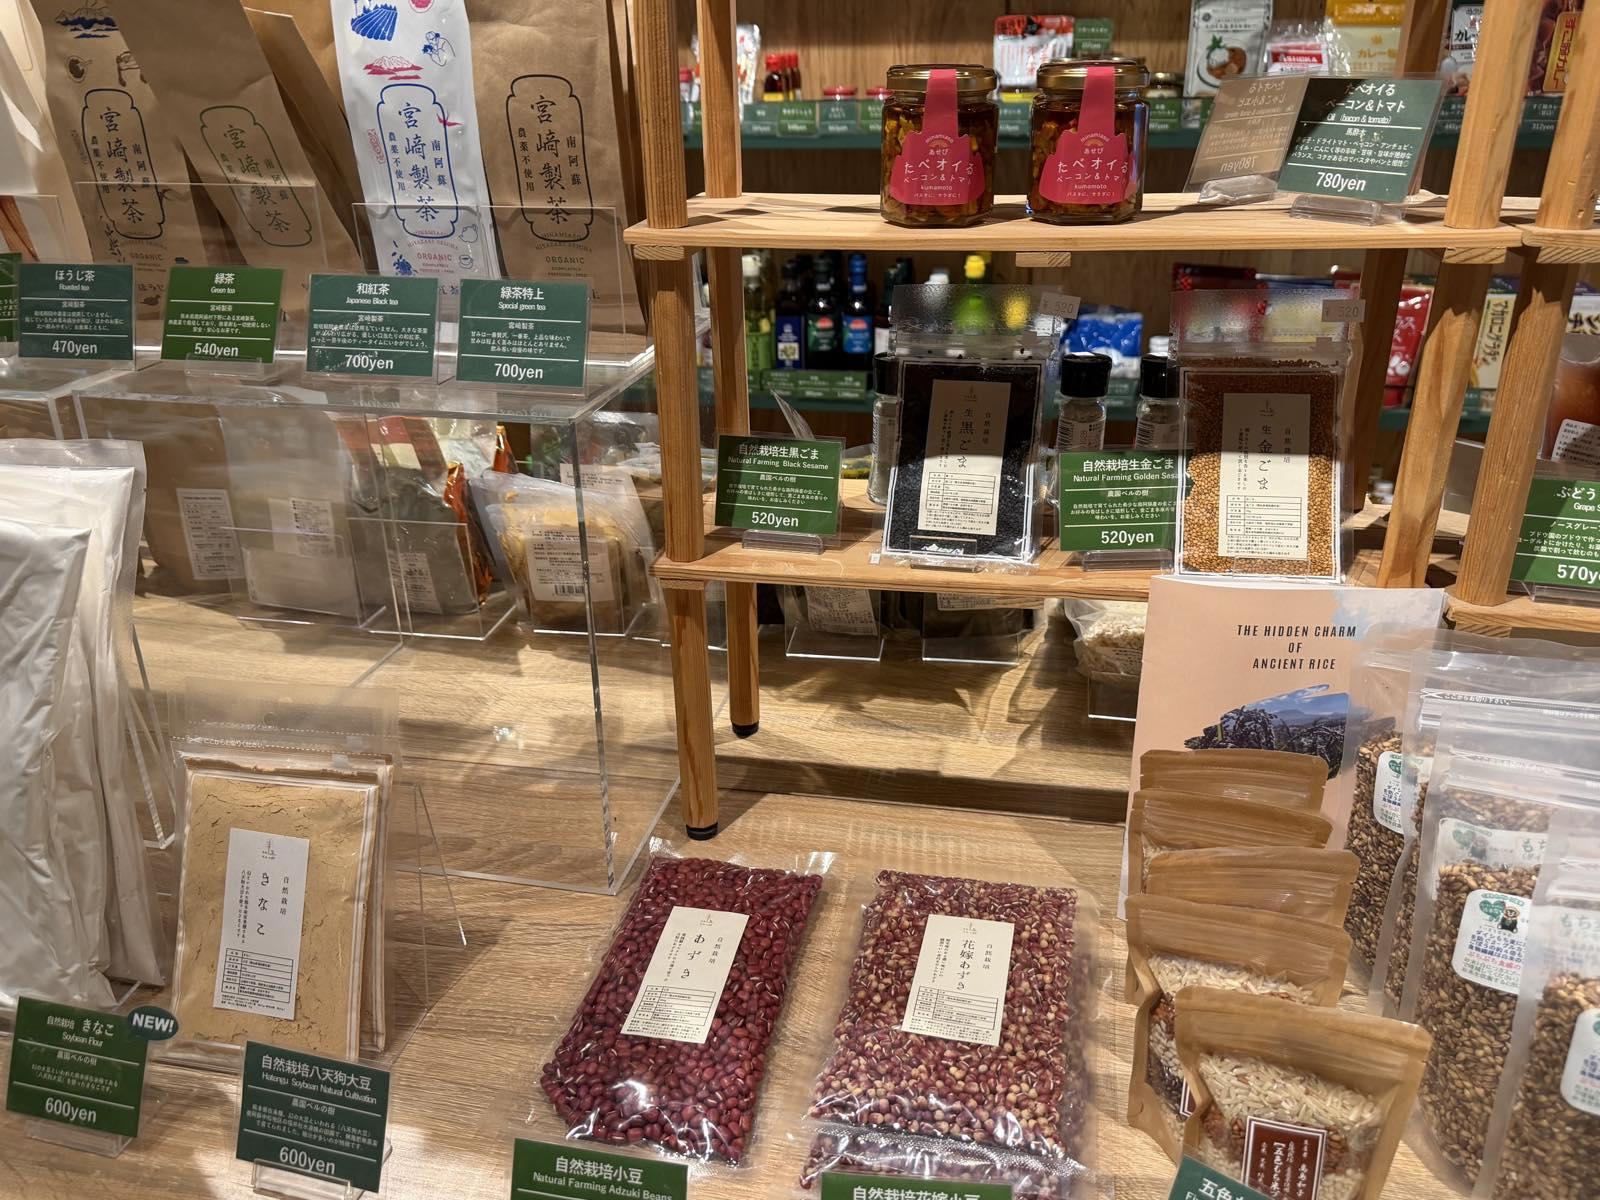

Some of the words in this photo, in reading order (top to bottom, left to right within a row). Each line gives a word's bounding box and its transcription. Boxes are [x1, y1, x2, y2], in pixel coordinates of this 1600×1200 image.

[1316, 171, 1366, 192] 780yen
[417, 252, 452, 261] ORGANIC
[545, 255, 585, 264] ORGANIC
[55, 269, 95, 283] ほうじ茶
[214, 272, 235, 285] 緑茶
[210, 286, 225, 295] Green
[356, 282, 390, 296] 和紅茶
[500, 286, 544, 301] 緑茶特上
[346, 297, 371, 306] Japanese
[372, 298, 389, 306] Black
[498, 302, 518, 310] Special
[518, 303, 536, 311] green
[52, 340, 98, 355] 470yen
[194, 342, 239, 358] 540yen
[344, 354, 394, 371] 700yen
[494, 363, 543, 380] 700yen
[738, 444, 819, 460] 自然栽培生黒ごま
[1257, 424, 1273, 490] 生金ごま
[727, 456, 752, 465] Natural
[752, 457, 780, 468] Farming
[782, 460, 801, 468] Black
[802, 461, 829, 470] Sesame
[1083, 458, 1174, 472] 自然栽培生金ごま
[1073, 474, 1100, 482] Natural
[1102, 473, 1132, 482] Farming
[1134, 472, 1160, 480] Golden
[1161, 471, 1179, 480] Sesa
[1554, 486, 1596, 500] ぶどう
[1573, 502, 1595, 512] Grape
[751, 511, 799, 528] 520yen
[1101, 530, 1154, 546] 520yen
[1557, 564, 1600, 584] 570y
[1236, 624, 1259, 636] THE
[1264, 625, 1309, 637] HIDDEN
[1314, 626, 1356, 637] CHARM
[1288, 642, 1302, 653] OF
[1252, 658, 1305, 670] ANCIENT
[1309, 658, 1336, 670] RICE
[256, 872, 270, 936] きなこ
[681, 933, 705, 979] あずき
[956, 939, 976, 990] 花嫁あずき
[47, 1015, 75, 1030] 自然栽培
[82, 1018, 115, 1037] きなこ
[132, 1012, 175, 1033] NEW!
[62, 1031, 88, 1044] Soybean
[88, 1035, 104, 1047] Flour
[261, 1054, 372, 1091] 自然栽培八天狗大豆
[262, 1071, 289, 1086] Hatengu
[291, 1077, 319, 1092] Soybean
[319, 1083, 343, 1097] Natural
[344, 1089, 377, 1105] Cultivation
[45, 1097, 97, 1123] 600yen
[279, 1146, 336, 1175] 600yen
[555, 1155, 644, 1185] 自然栽培小豆
[533, 1171, 566, 1187] Natural
[568, 1177, 607, 1194] Farming
[608, 1185, 640, 1199] Adzuki
